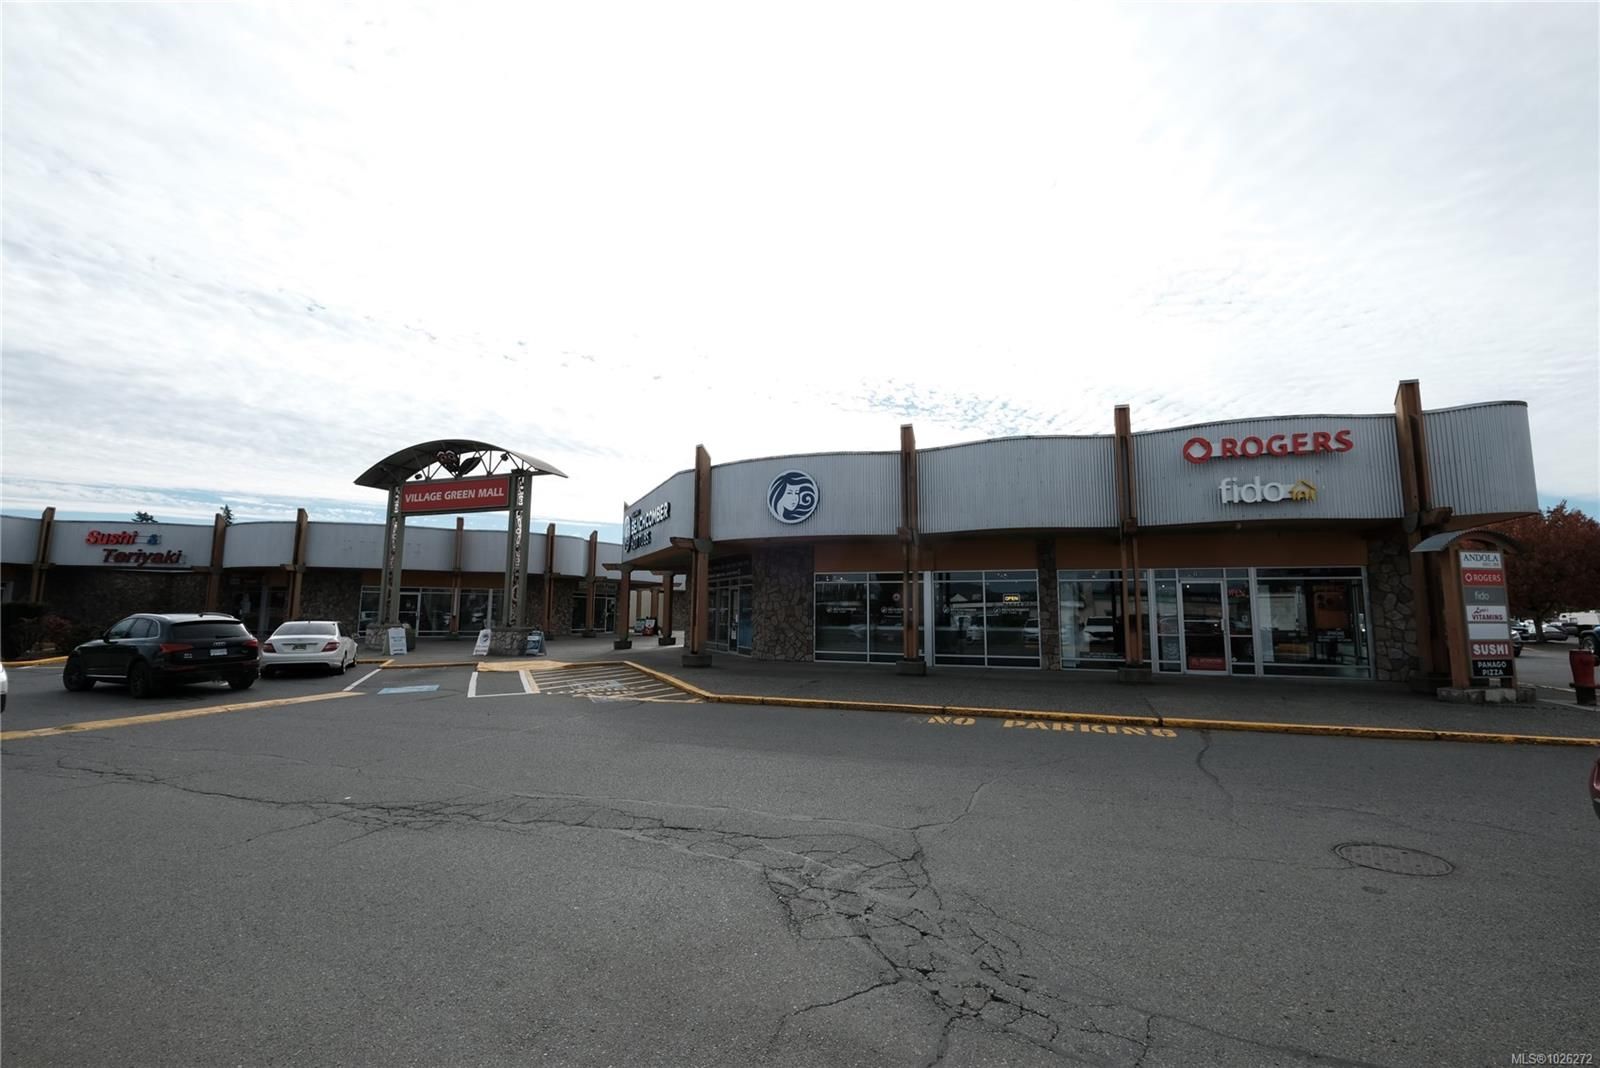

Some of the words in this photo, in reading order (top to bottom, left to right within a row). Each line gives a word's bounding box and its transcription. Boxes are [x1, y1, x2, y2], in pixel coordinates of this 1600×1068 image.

[1221, 430, 1354, 459] ROGERS
[405, 491, 442, 503] VILLAGE
[444, 489, 475, 500] GREEN
[478, 487, 504, 498] MALL
[1219, 475, 1284, 504] fido
[86, 529, 138, 545] Sushi
[147, 534, 158, 545] &
[103, 549, 183, 567] Teriyaki
[1464, 554, 1498, 562] ANDOLA
[1473, 573, 1501, 582] ROGERS
[1473, 644, 1509, 655] SUSHI
[927, 715, 976, 726] NO
[1003, 719, 1179, 738] PARKING
